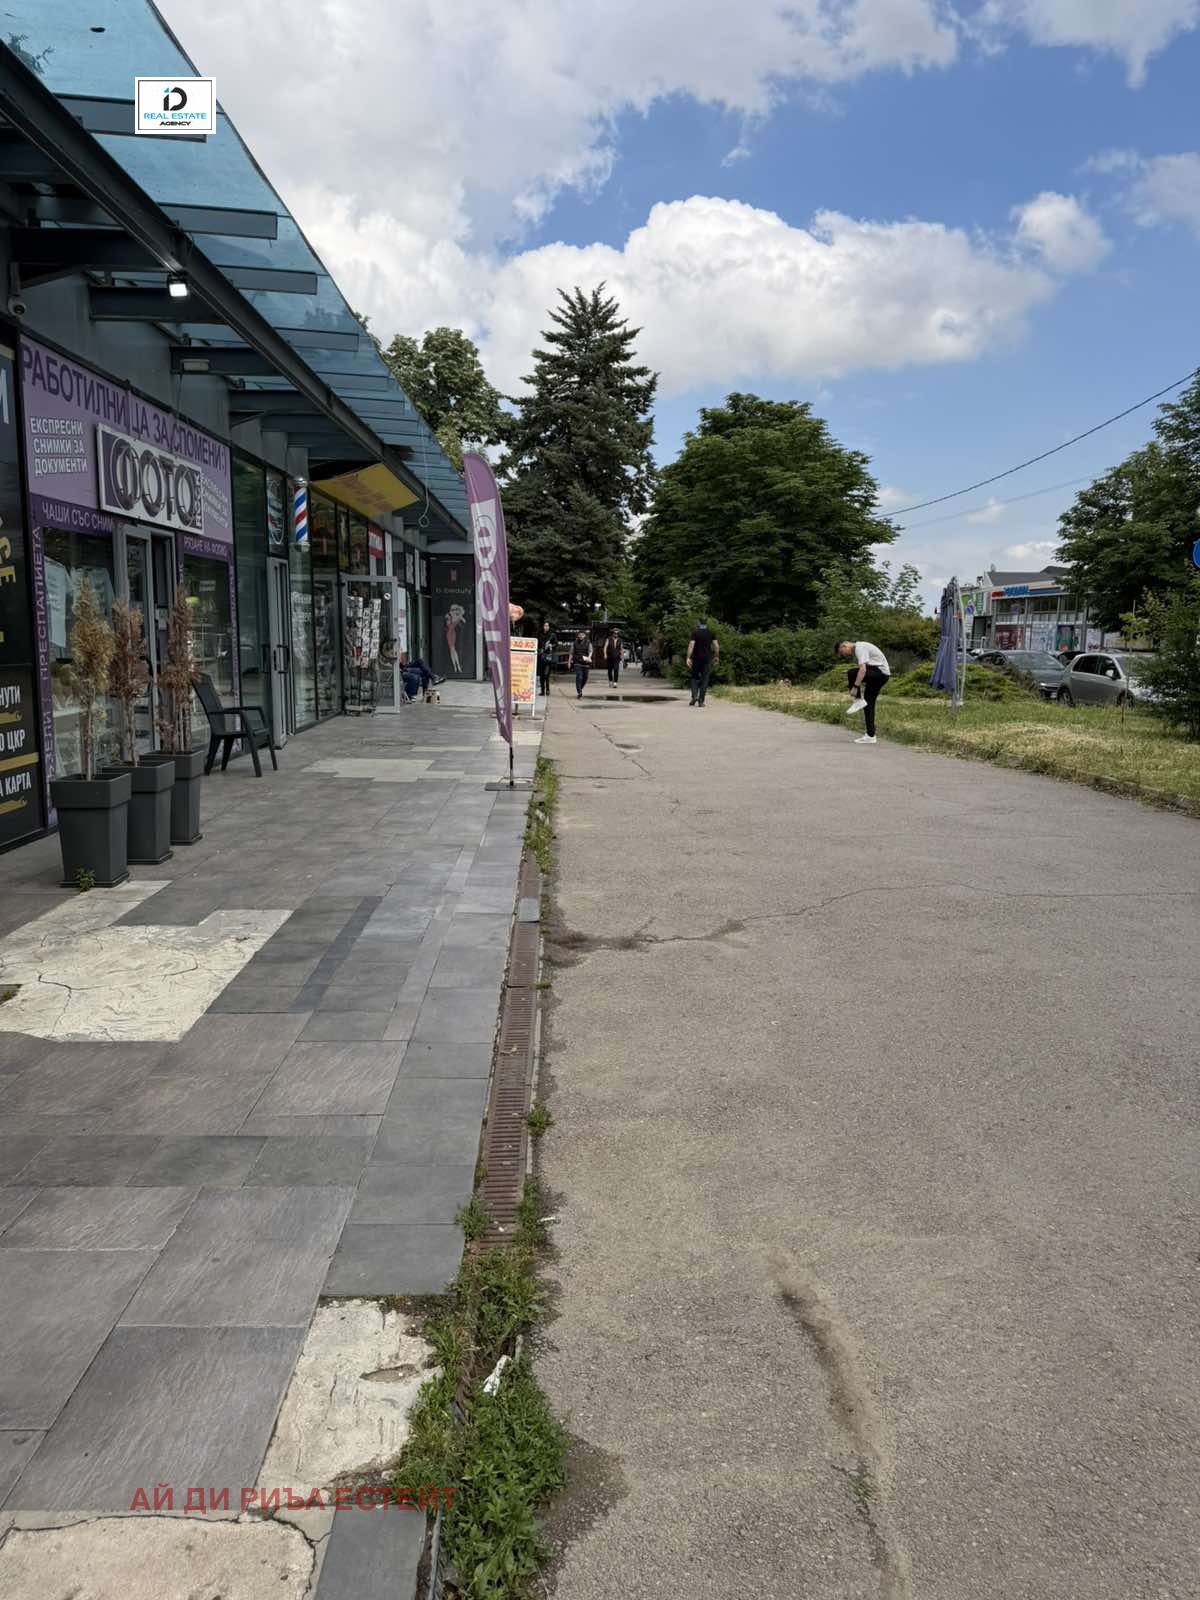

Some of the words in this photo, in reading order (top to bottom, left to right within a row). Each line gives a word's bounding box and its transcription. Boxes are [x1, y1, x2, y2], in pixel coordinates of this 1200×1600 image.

[30, 417, 84, 434] ЕКСПРЕСНИ
[153, 412, 169, 447] ЗА
[33, 438, 72, 454] СНИМКИ
[74, 438, 85, 454] ЗА
[34, 458, 88, 477] ДОКУМЕНТИ
[42, 501, 70, 524] ЧАШИ
[71, 508, 90, 527] СЪС
[91, 513, 113, 532] СНИМ
[32, 526, 49, 680] ПРЕСПАПИЕТА
[0, 685, 21, 709] НУТИ
[7, 729, 26, 753] ЦКР
[5, 771, 32, 795] КАРТА
